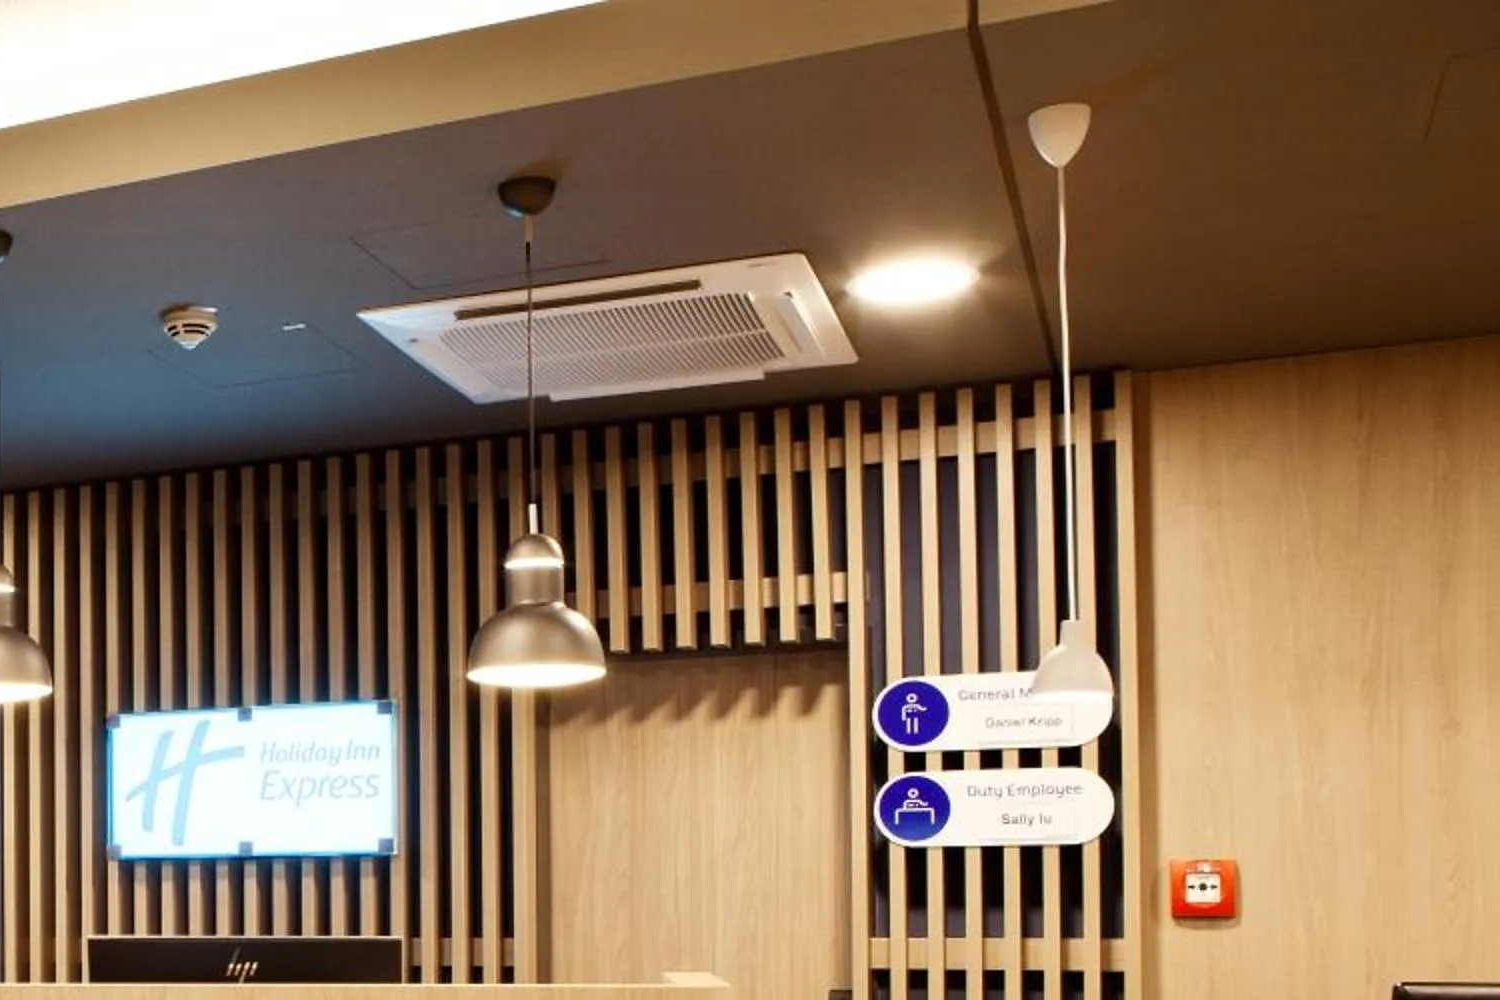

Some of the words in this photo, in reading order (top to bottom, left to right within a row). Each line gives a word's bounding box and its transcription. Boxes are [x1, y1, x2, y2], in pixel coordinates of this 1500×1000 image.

[957, 687, 1015, 701] General
[260, 741, 343, 767] Holiday
[346, 738, 381, 762] Inn
[260, 769, 381, 808] Express
[966, 784, 1003, 800] Duty
[1007, 782, 1084, 799] Employee
[1001, 812, 1035, 828] Sally
[226, 946, 258, 985] hp
